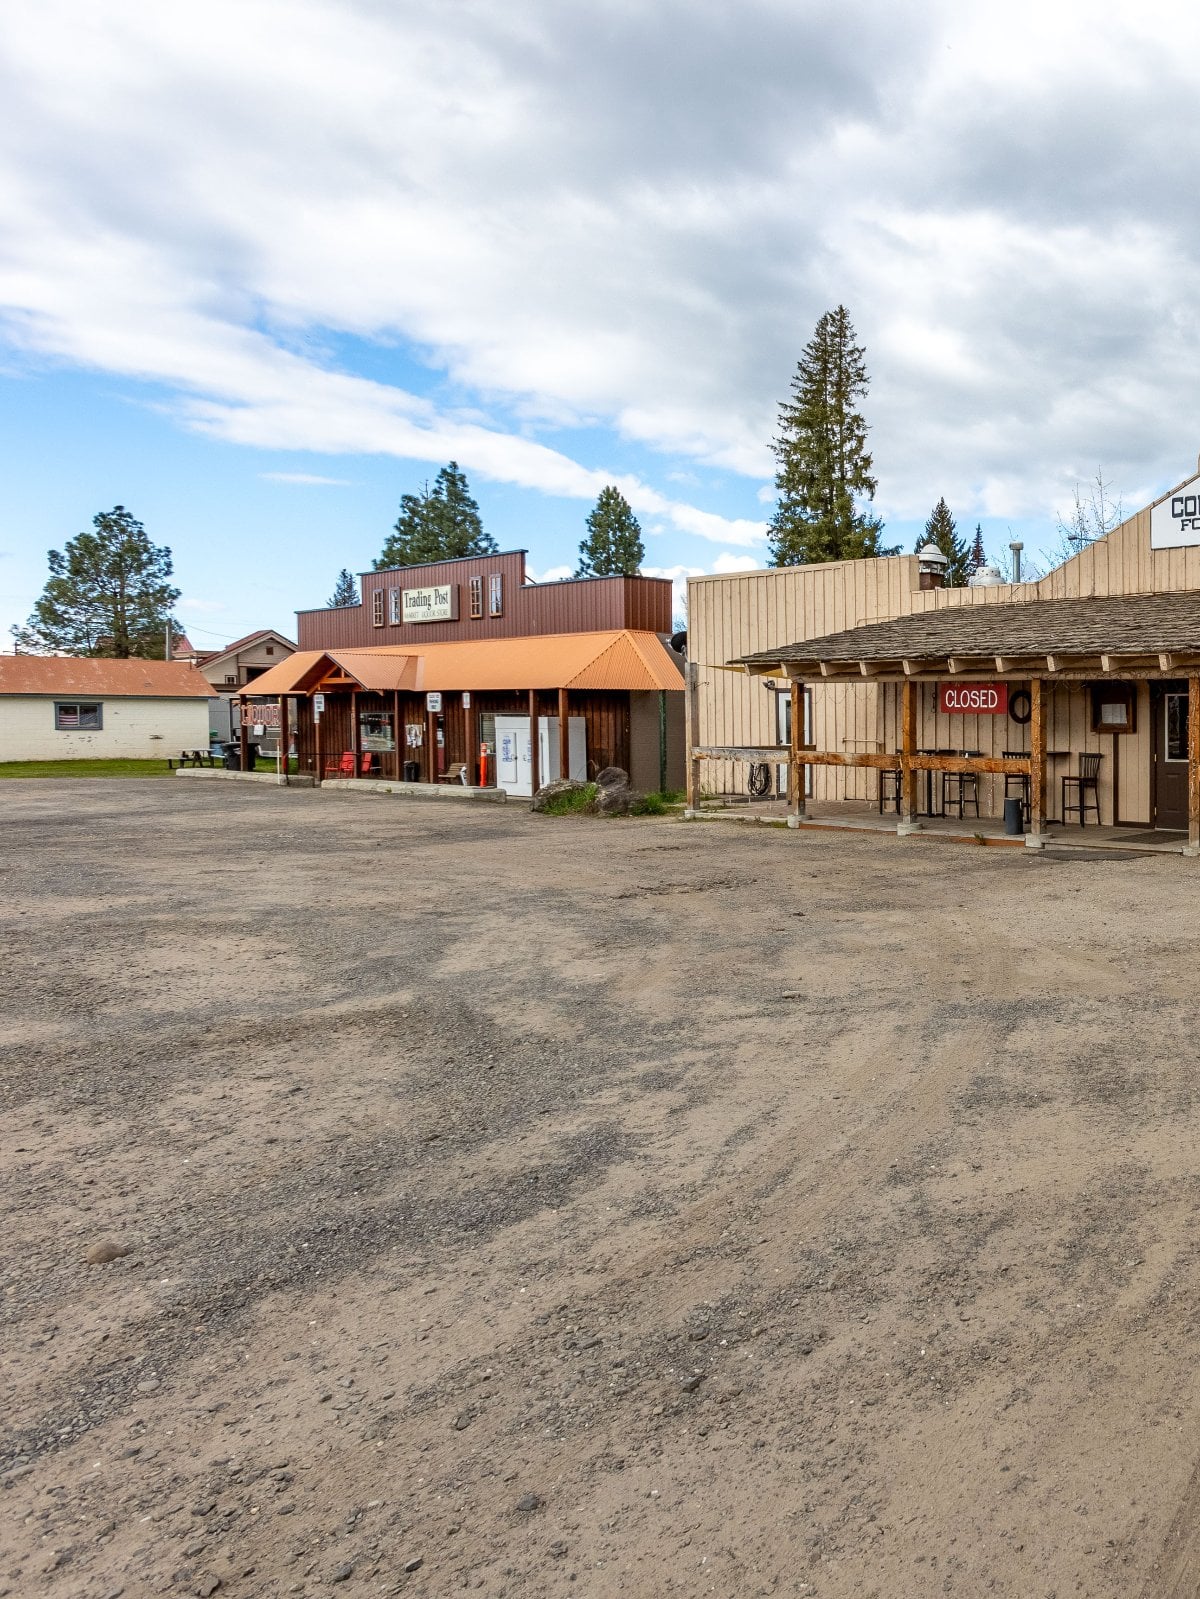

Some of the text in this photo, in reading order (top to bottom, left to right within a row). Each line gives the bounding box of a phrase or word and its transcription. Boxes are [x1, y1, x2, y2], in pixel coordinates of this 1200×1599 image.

[404, 588, 448, 610] Trading Post
[945, 690, 998, 708] CLOSED
